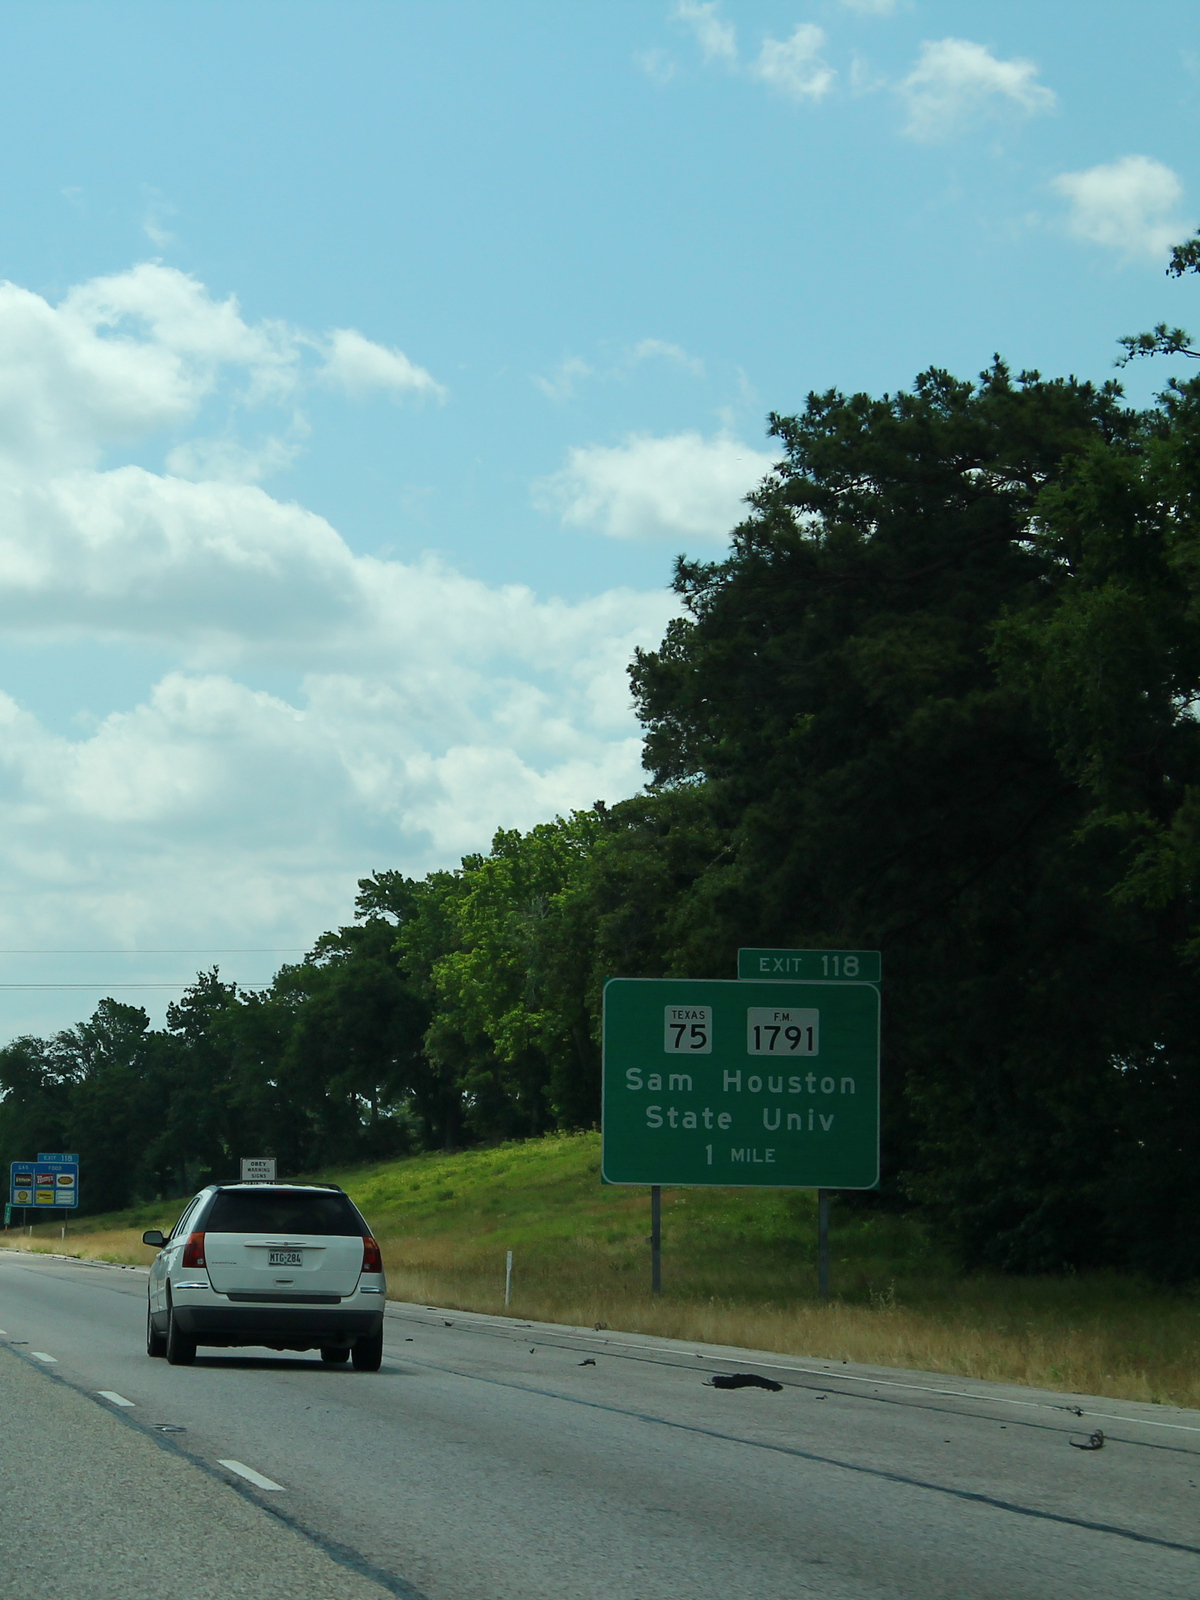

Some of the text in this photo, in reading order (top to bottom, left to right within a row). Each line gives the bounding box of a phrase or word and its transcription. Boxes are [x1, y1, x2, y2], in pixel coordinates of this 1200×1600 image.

[759, 955, 860, 977] EXIT 118
[672, 1010, 705, 1020] TEXAS
[669, 1023, 707, 1049] 75
[753, 1025, 814, 1051] 1791
[625, 1067, 856, 1094] Sam Houston
[645, 1105, 834, 1131] State Univ
[705, 1144, 776, 1165] 1 MILE
